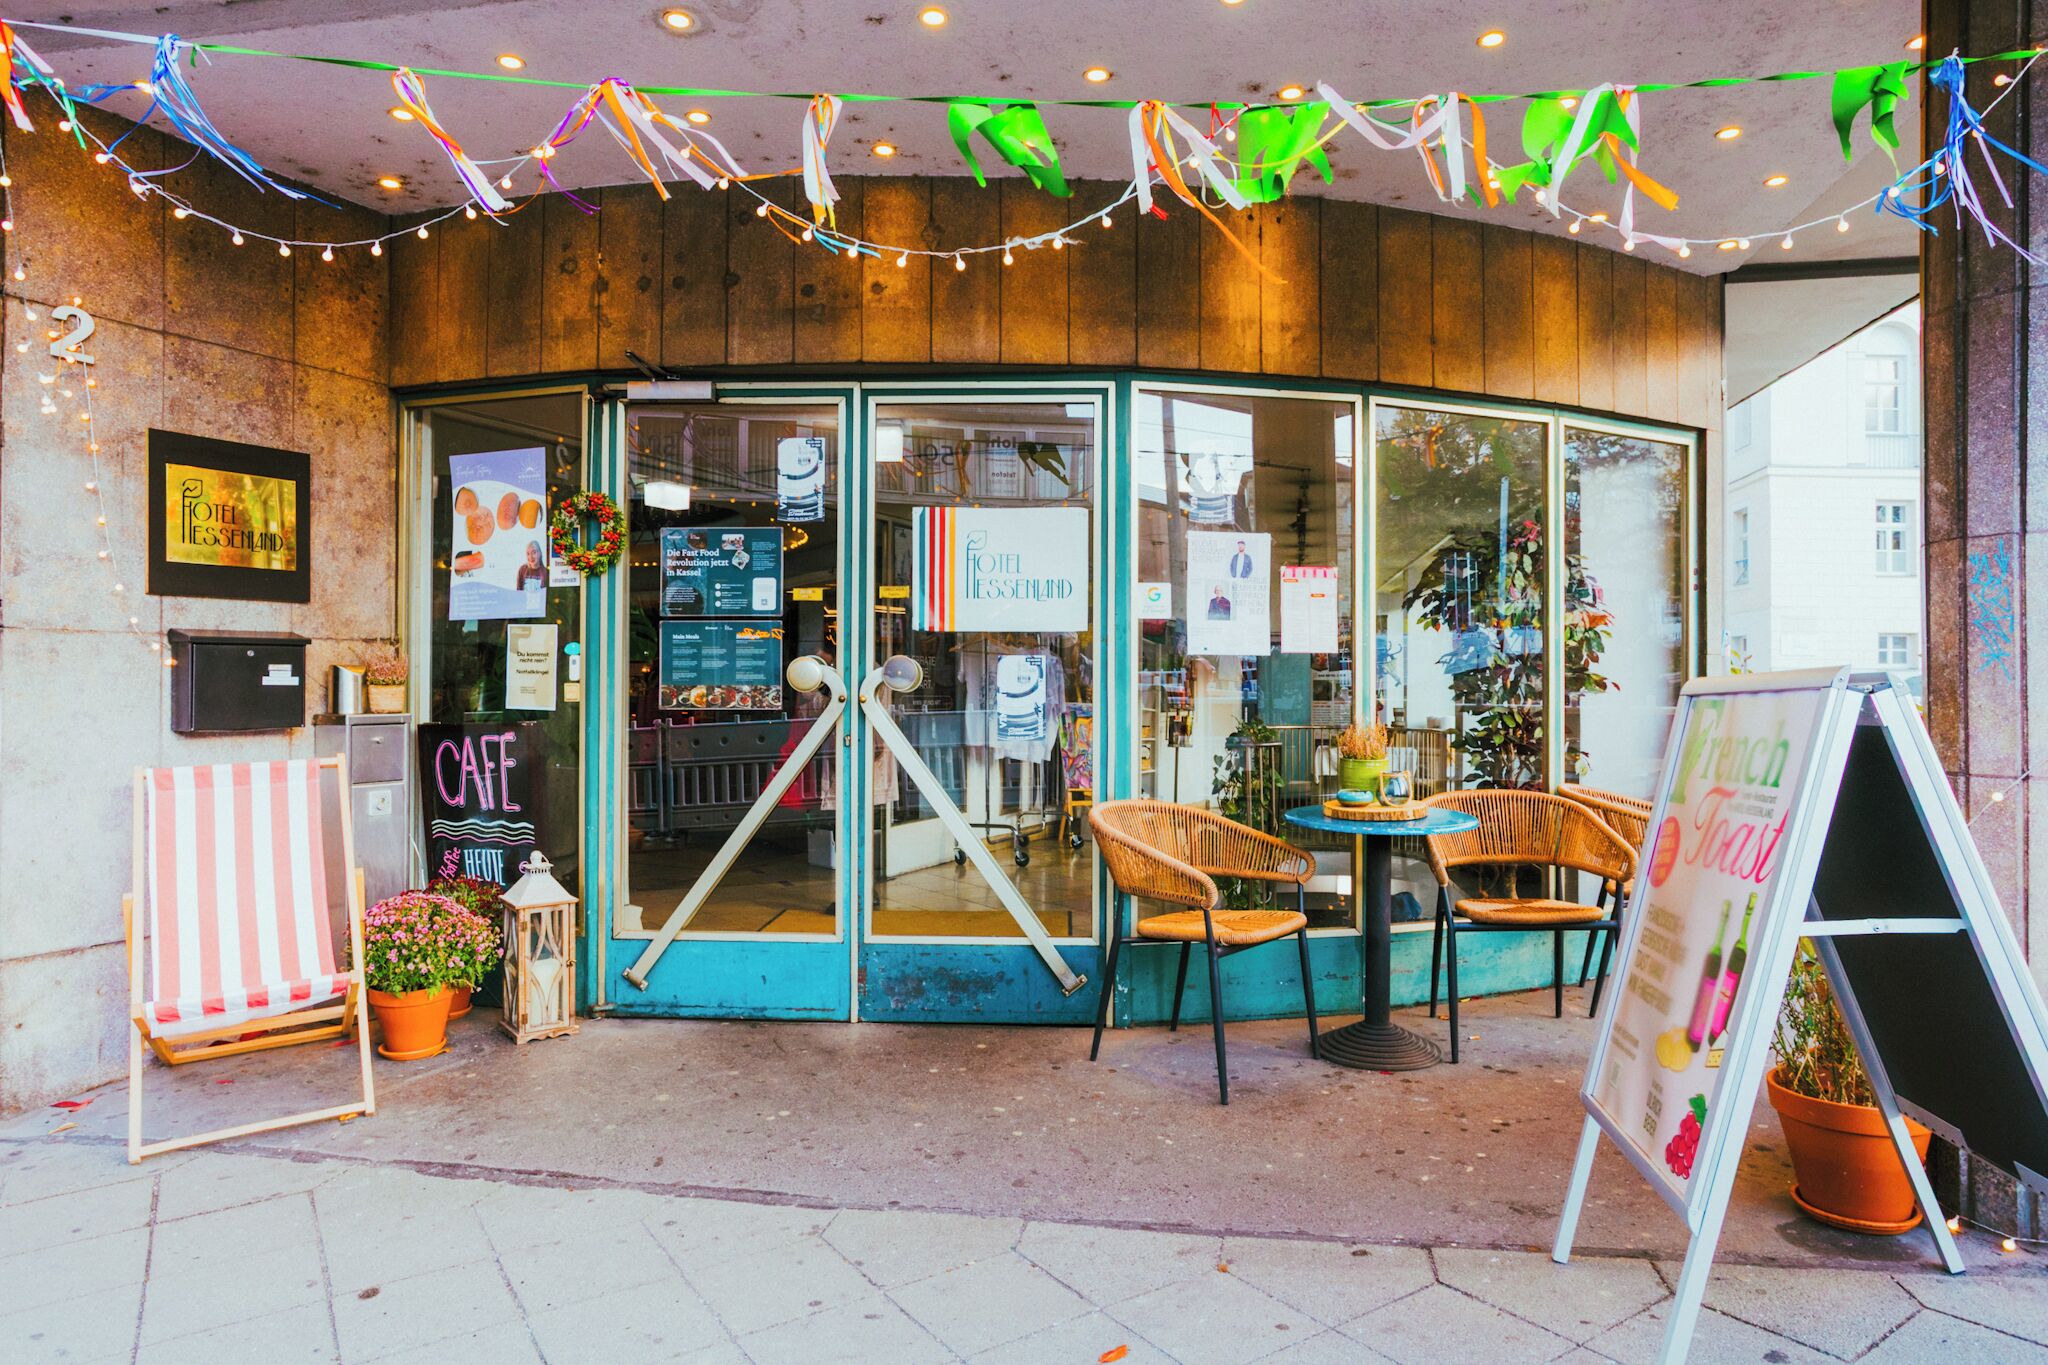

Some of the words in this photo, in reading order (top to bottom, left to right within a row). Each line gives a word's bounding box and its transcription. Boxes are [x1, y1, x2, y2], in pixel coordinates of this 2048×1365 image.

[50, 305, 96, 365] 2
[181, 522, 285, 554] HESSENLAND
[666, 549, 680, 557] Die
[682, 549, 699, 557] Fast
[700, 548, 720, 557] Food
[666, 558, 710, 567] Revolution
[710, 559, 729, 568] jetzt
[666, 569, 675, 577] in
[676, 568, 702, 577] Kassel
[966, 577, 1073, 602] HESSENLAND
[1668, 698, 1790, 805] French
[1684, 785, 1789, 884] Toast
[438, 846, 461, 880] Kaffee
[463, 848, 506, 886] HEUTE
